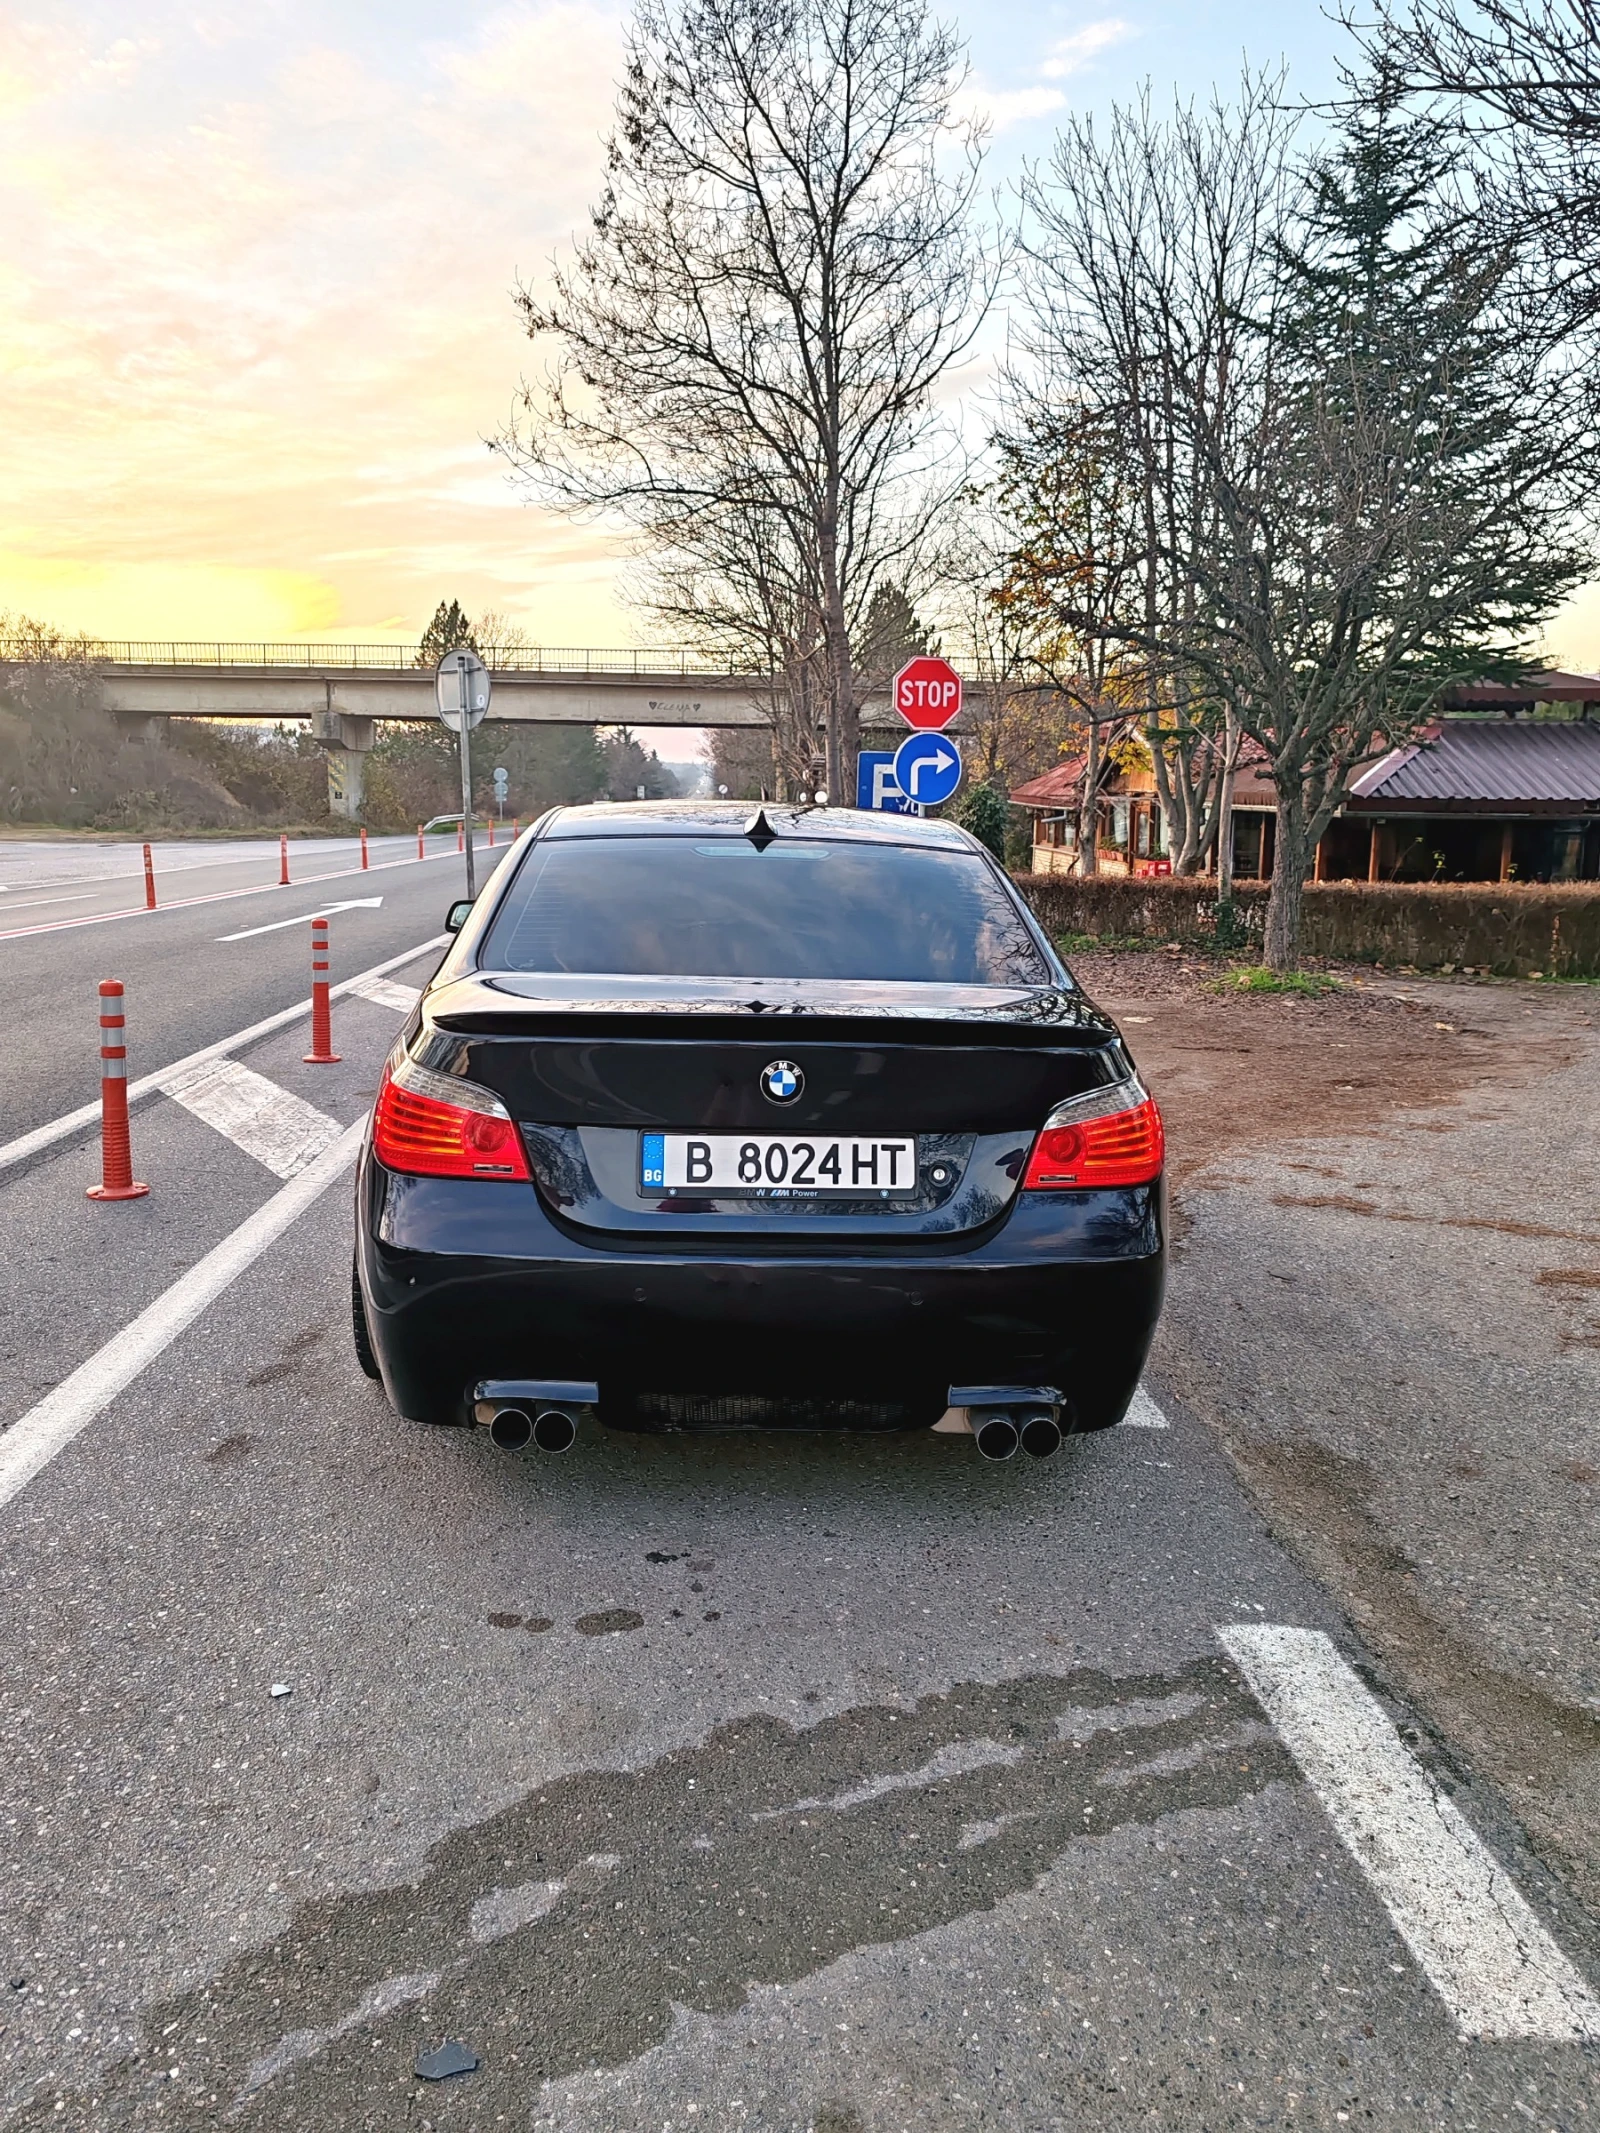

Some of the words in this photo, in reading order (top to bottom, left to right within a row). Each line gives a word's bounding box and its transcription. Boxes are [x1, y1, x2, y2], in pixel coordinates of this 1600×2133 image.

[901, 680, 956, 707] STOP
[872, 764, 903, 808] P
[765, 1062, 801, 1076] BMW
[687, 1142, 712, 1183] B
[644, 1169, 662, 1181] BG
[792, 1189, 818, 1197] Power
